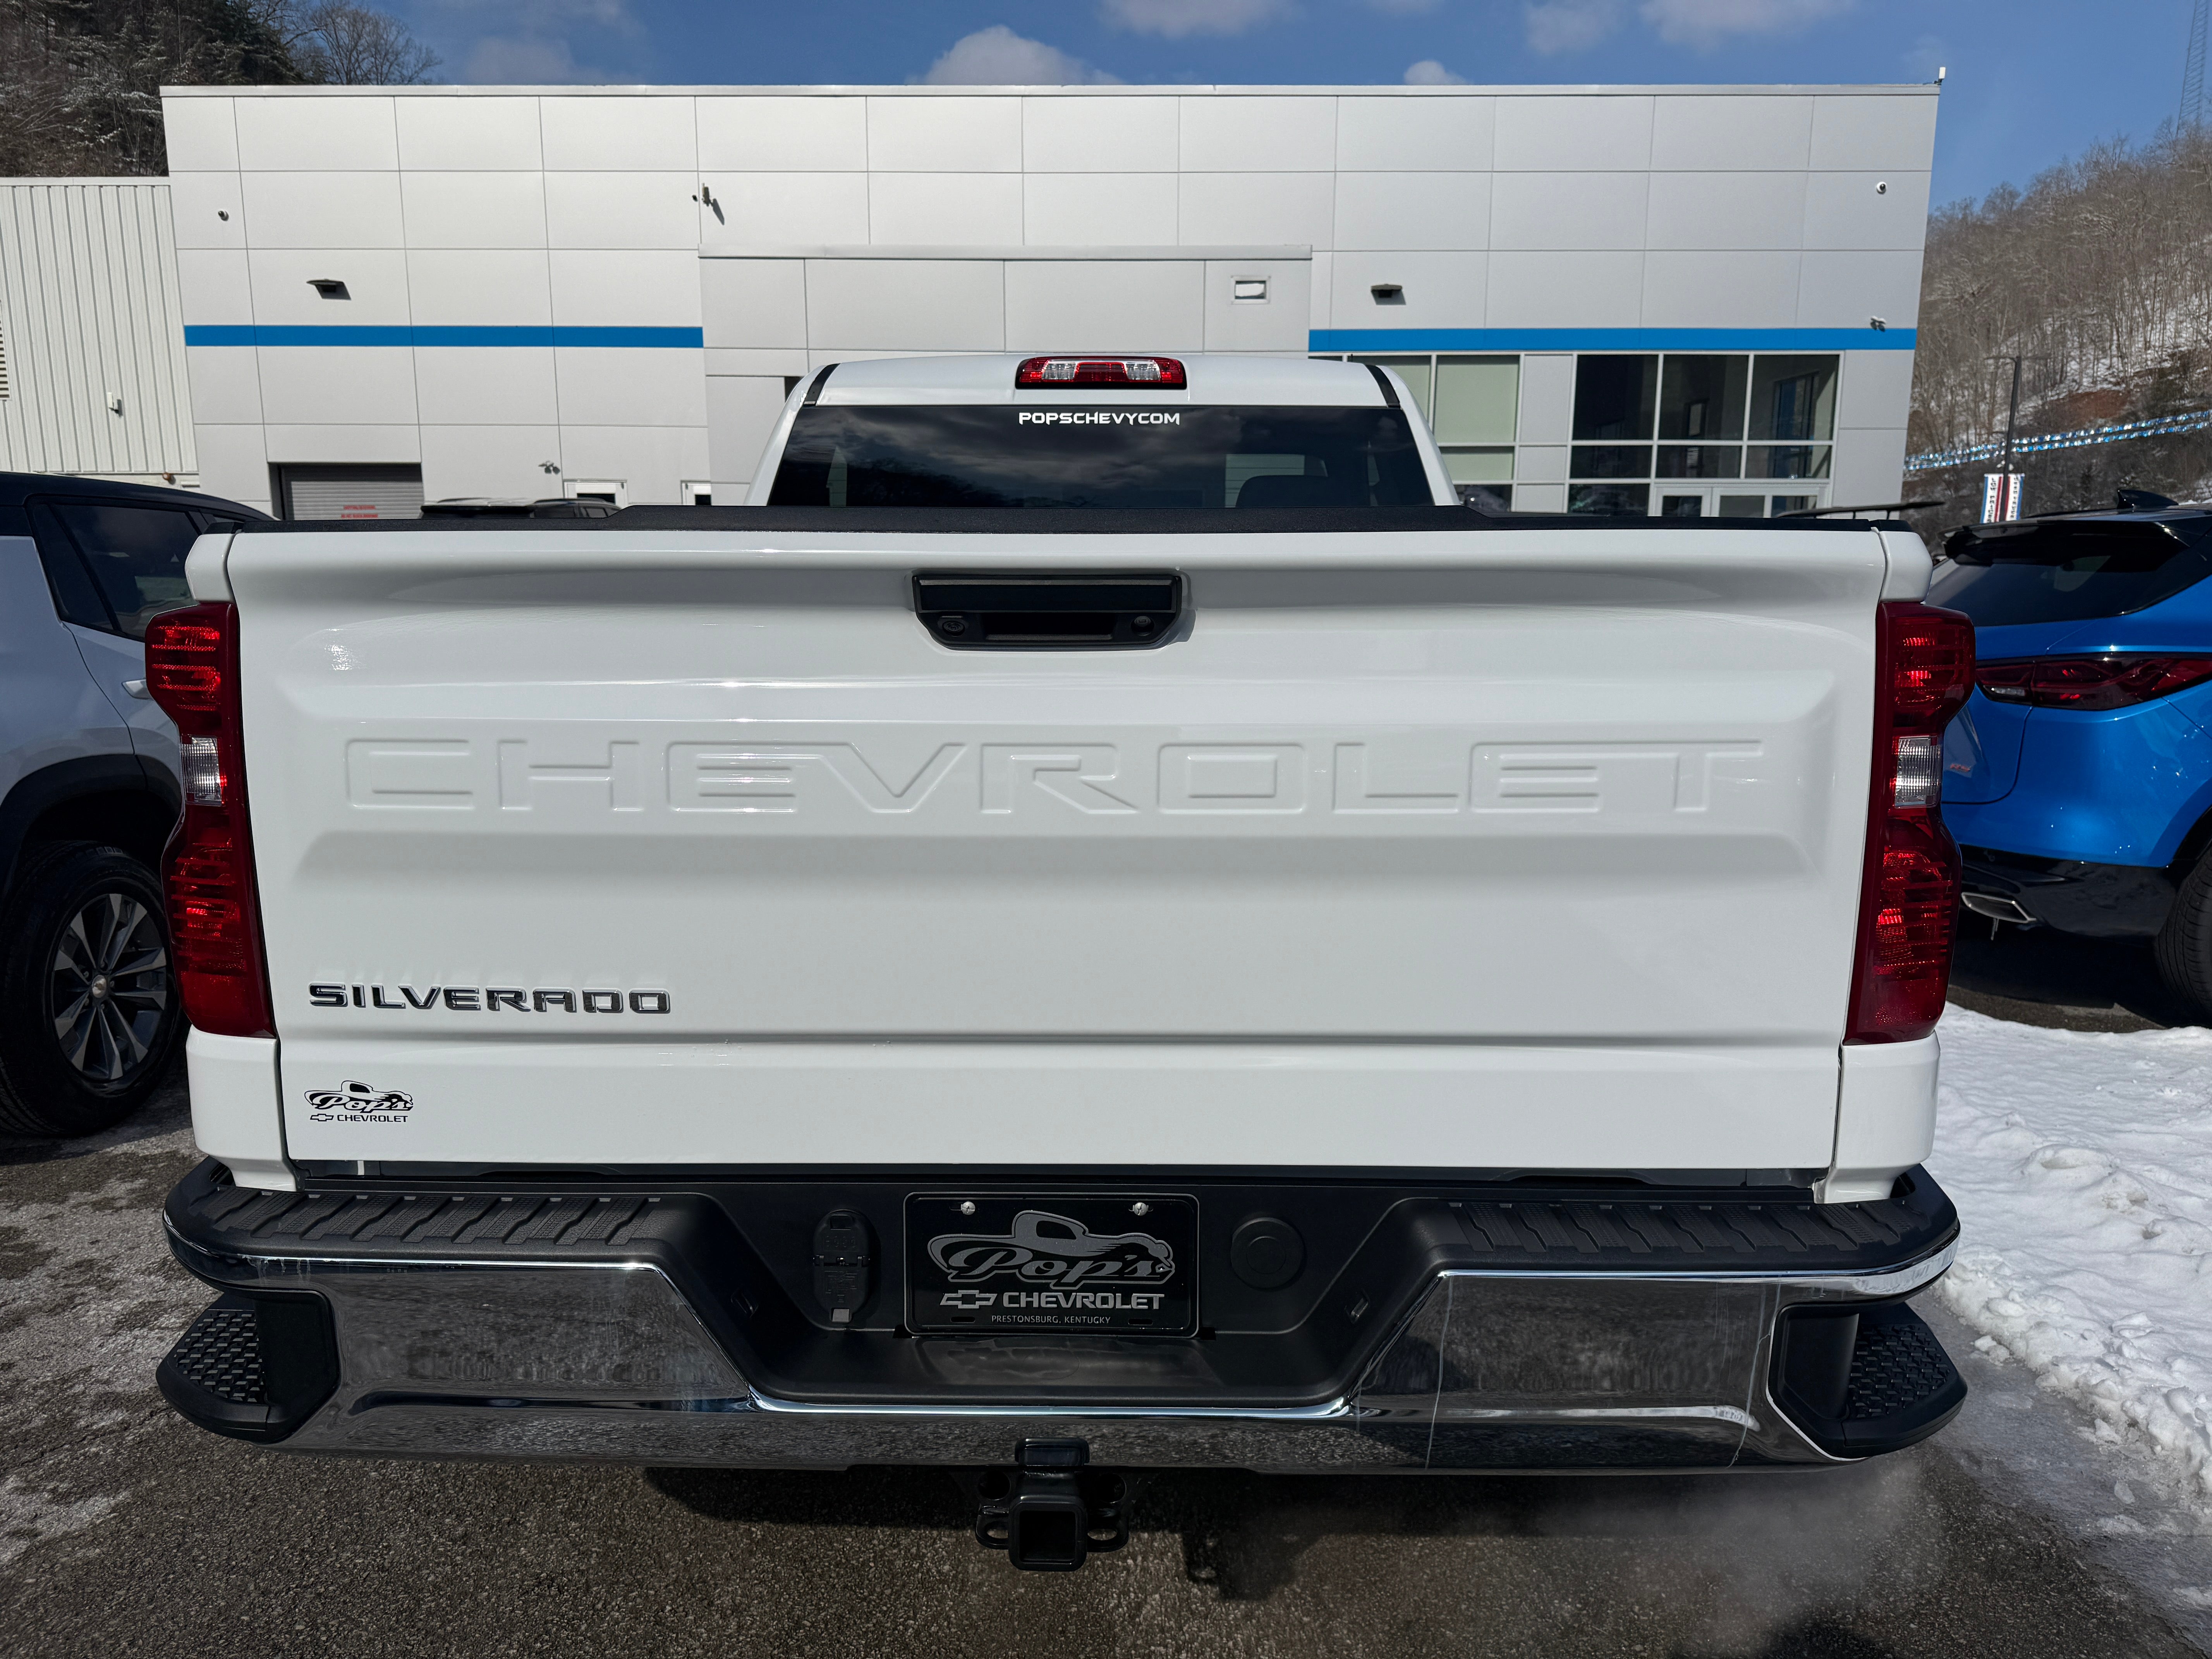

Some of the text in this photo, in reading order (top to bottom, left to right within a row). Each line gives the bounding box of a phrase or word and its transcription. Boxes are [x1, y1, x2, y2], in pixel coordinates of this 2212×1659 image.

[1019, 412, 1180, 425] POPSCHEVYCOM
[345, 738, 1764, 814] CHEVROLET
[308, 983, 671, 1013] SILVERADO
[337, 1114, 408, 1122] CHEVROLET
[948, 1247, 1161, 1283] Pop's
[1003, 1292, 1164, 1310] CHEVROLET
[991, 1315, 1111, 1324] PRESTONSBURG, KENTUCKY
